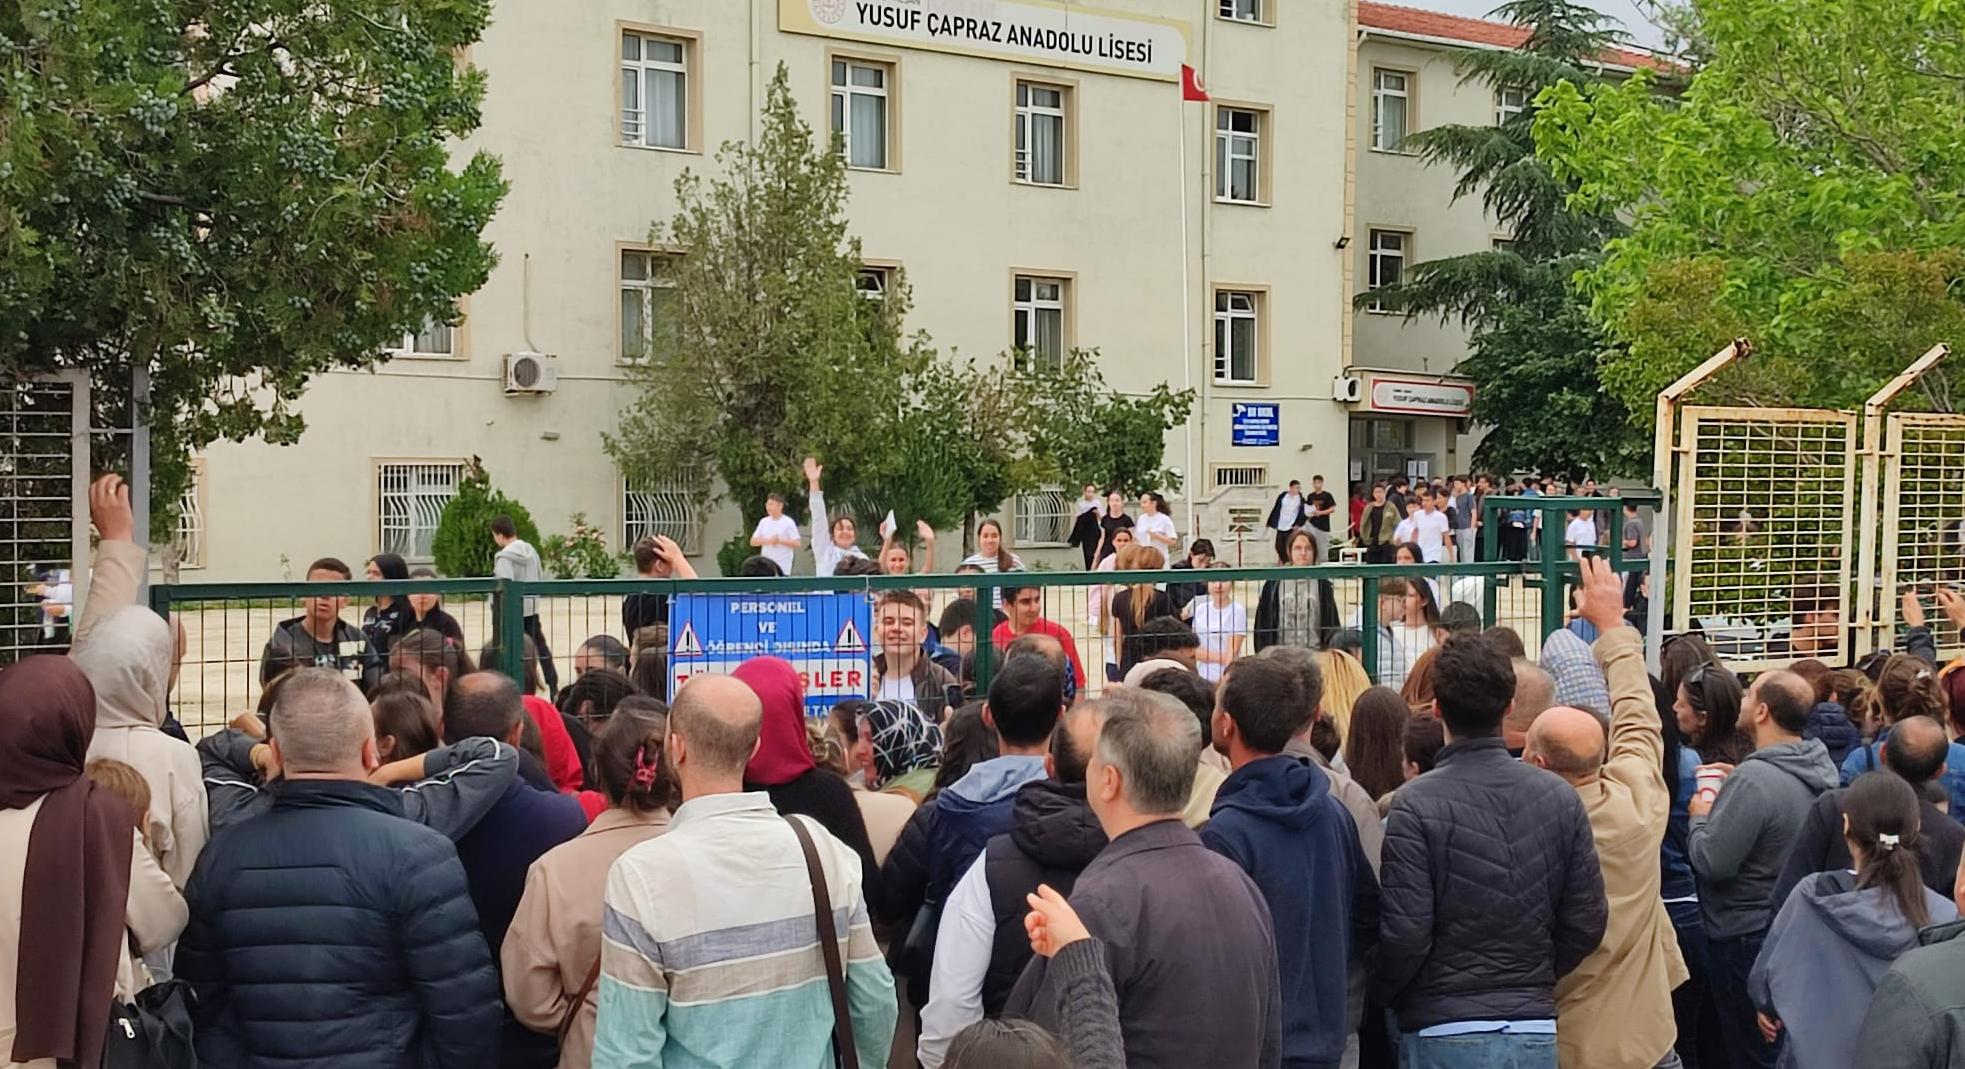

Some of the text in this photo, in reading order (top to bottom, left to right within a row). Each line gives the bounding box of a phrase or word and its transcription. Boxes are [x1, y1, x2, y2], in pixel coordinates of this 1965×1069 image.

[856, 2, 1152, 64] YUSUF ÇAPRAZ ANADOLU LİSESİ
[730, 601, 806, 614] PERSONEL
[758, 621, 777, 634] VE
